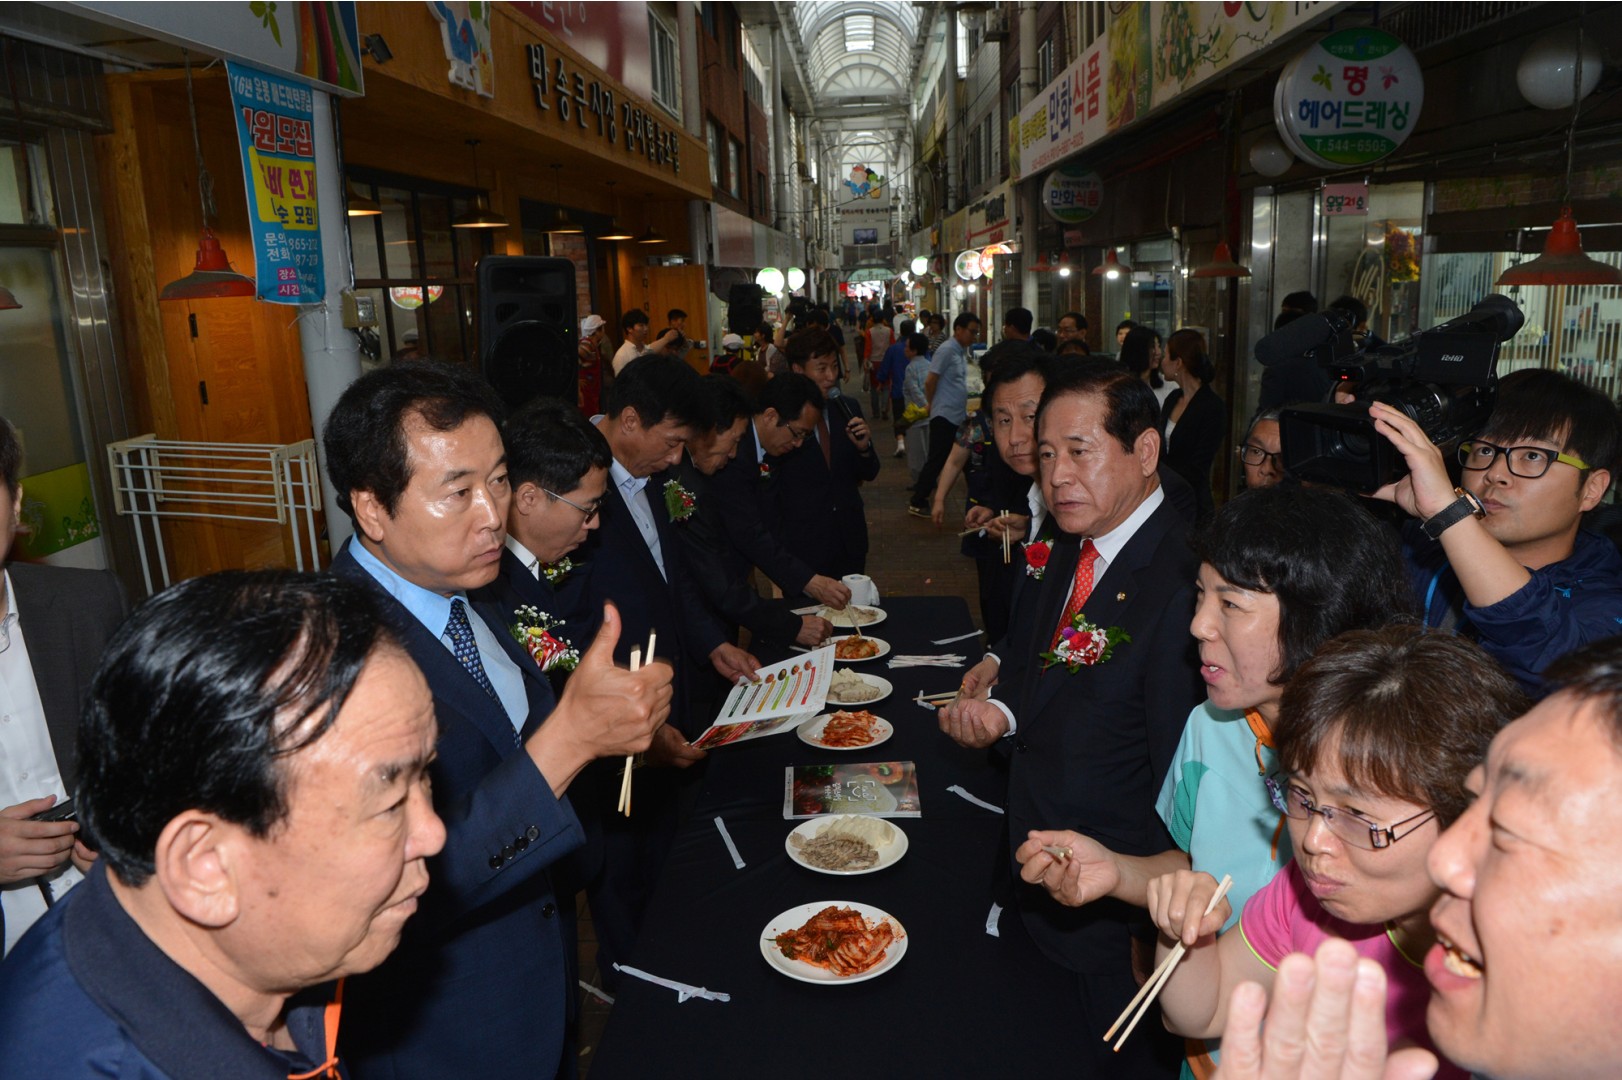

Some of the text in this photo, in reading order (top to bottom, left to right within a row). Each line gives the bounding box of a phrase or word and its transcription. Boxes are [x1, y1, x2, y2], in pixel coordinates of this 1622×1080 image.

[527, 43, 617, 143] 반송큰시장
[1049, 51, 1101, 142] 만화식품
[1343, 65, 1369, 96] 명
[243, 107, 314, 157] 원모집
[1299, 99, 1410, 131] 헤어드레싱
[260, 163, 284, 199] 비
[279, 269, 297, 280] 장소
[279, 284, 300, 296] 시간
